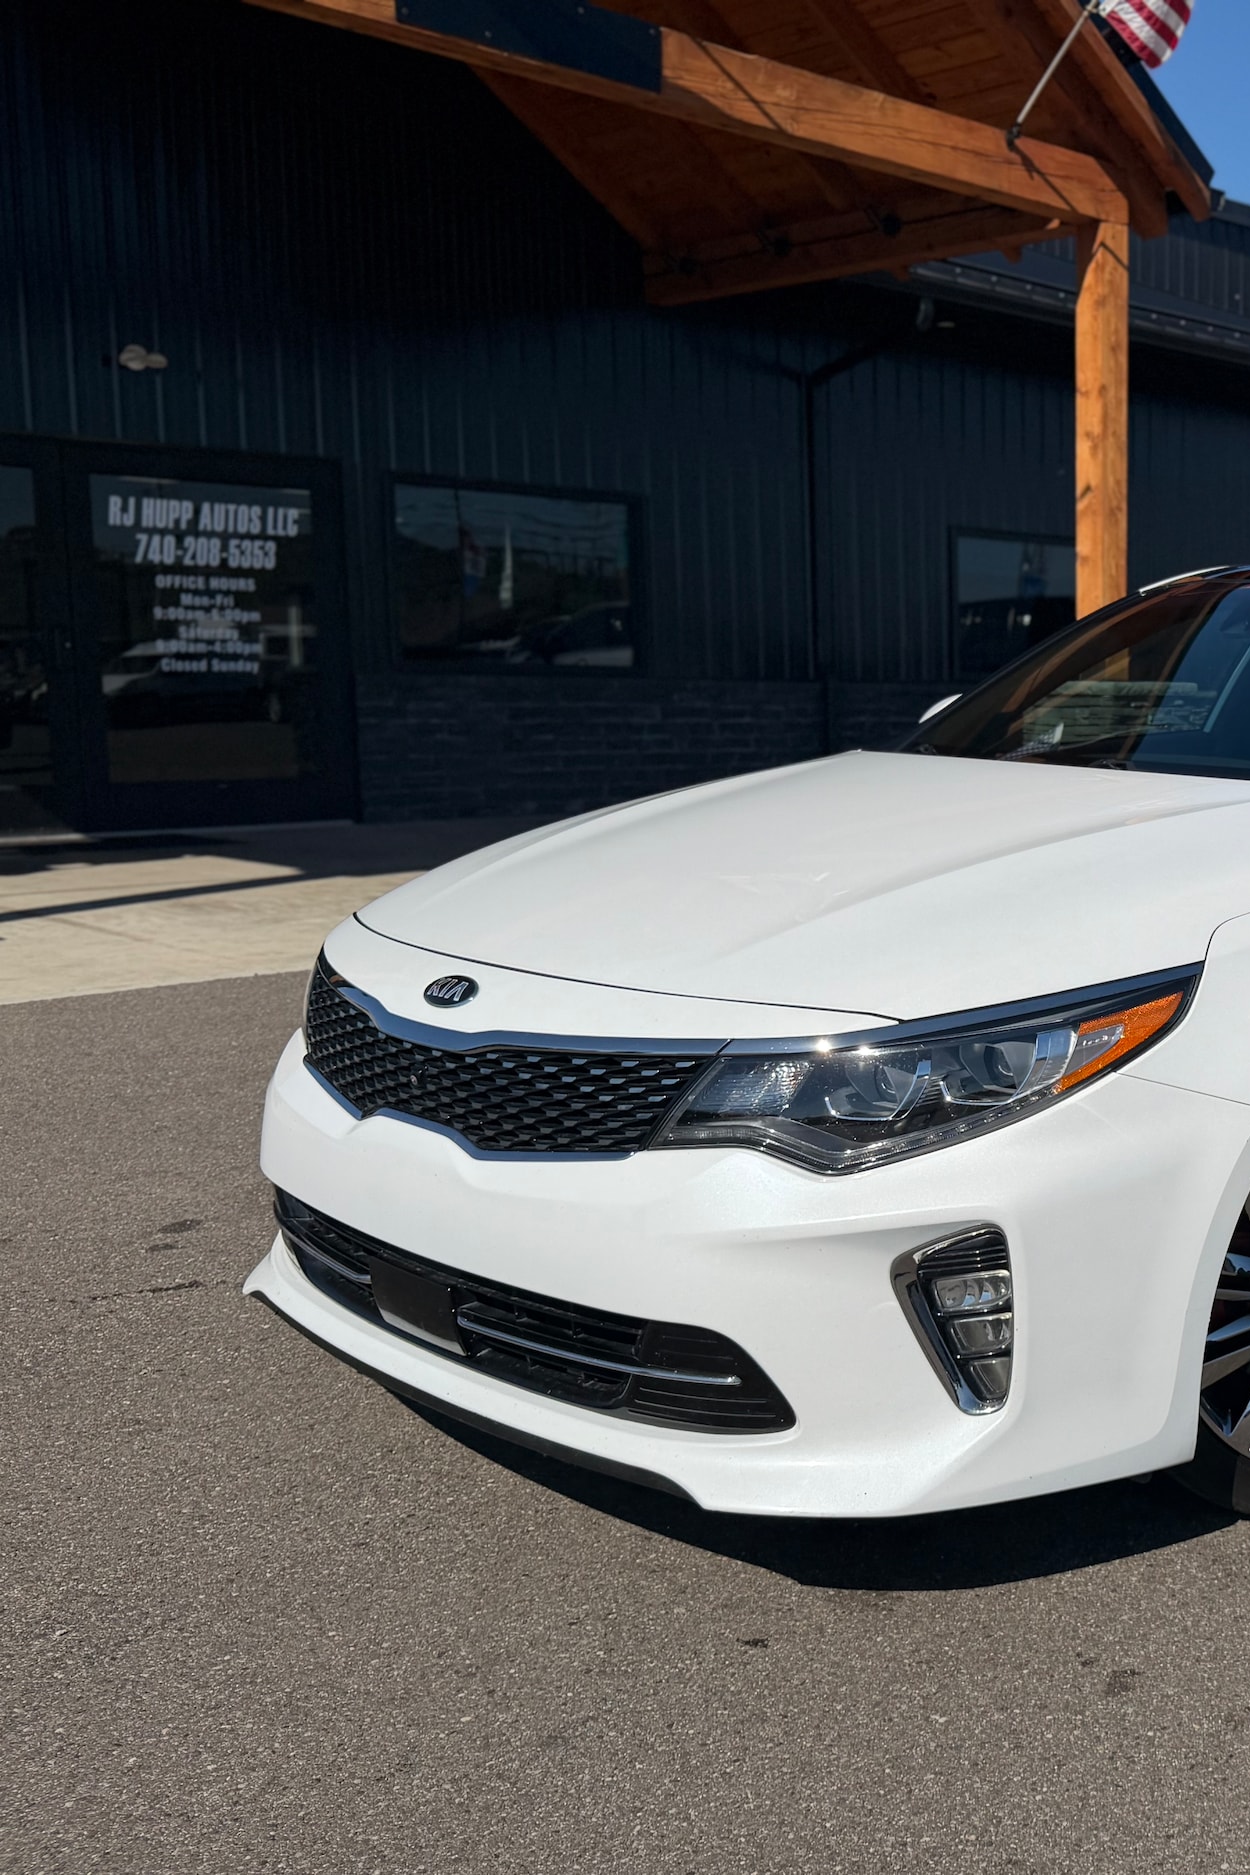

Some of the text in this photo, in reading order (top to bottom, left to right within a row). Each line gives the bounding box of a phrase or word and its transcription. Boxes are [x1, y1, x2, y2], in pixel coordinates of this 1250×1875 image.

[108, 496, 299, 537] RJ HUPP AUTOS LLC
[135, 534, 277, 570] 740-208-5353
[154, 574, 256, 592] OFFICE HOURS
[180, 592, 235, 607] Mon-Fri
[178, 625, 239, 641] Saturday
[160, 657, 260, 675] Closed Sunday
[427, 978, 469, 1002] KIA
